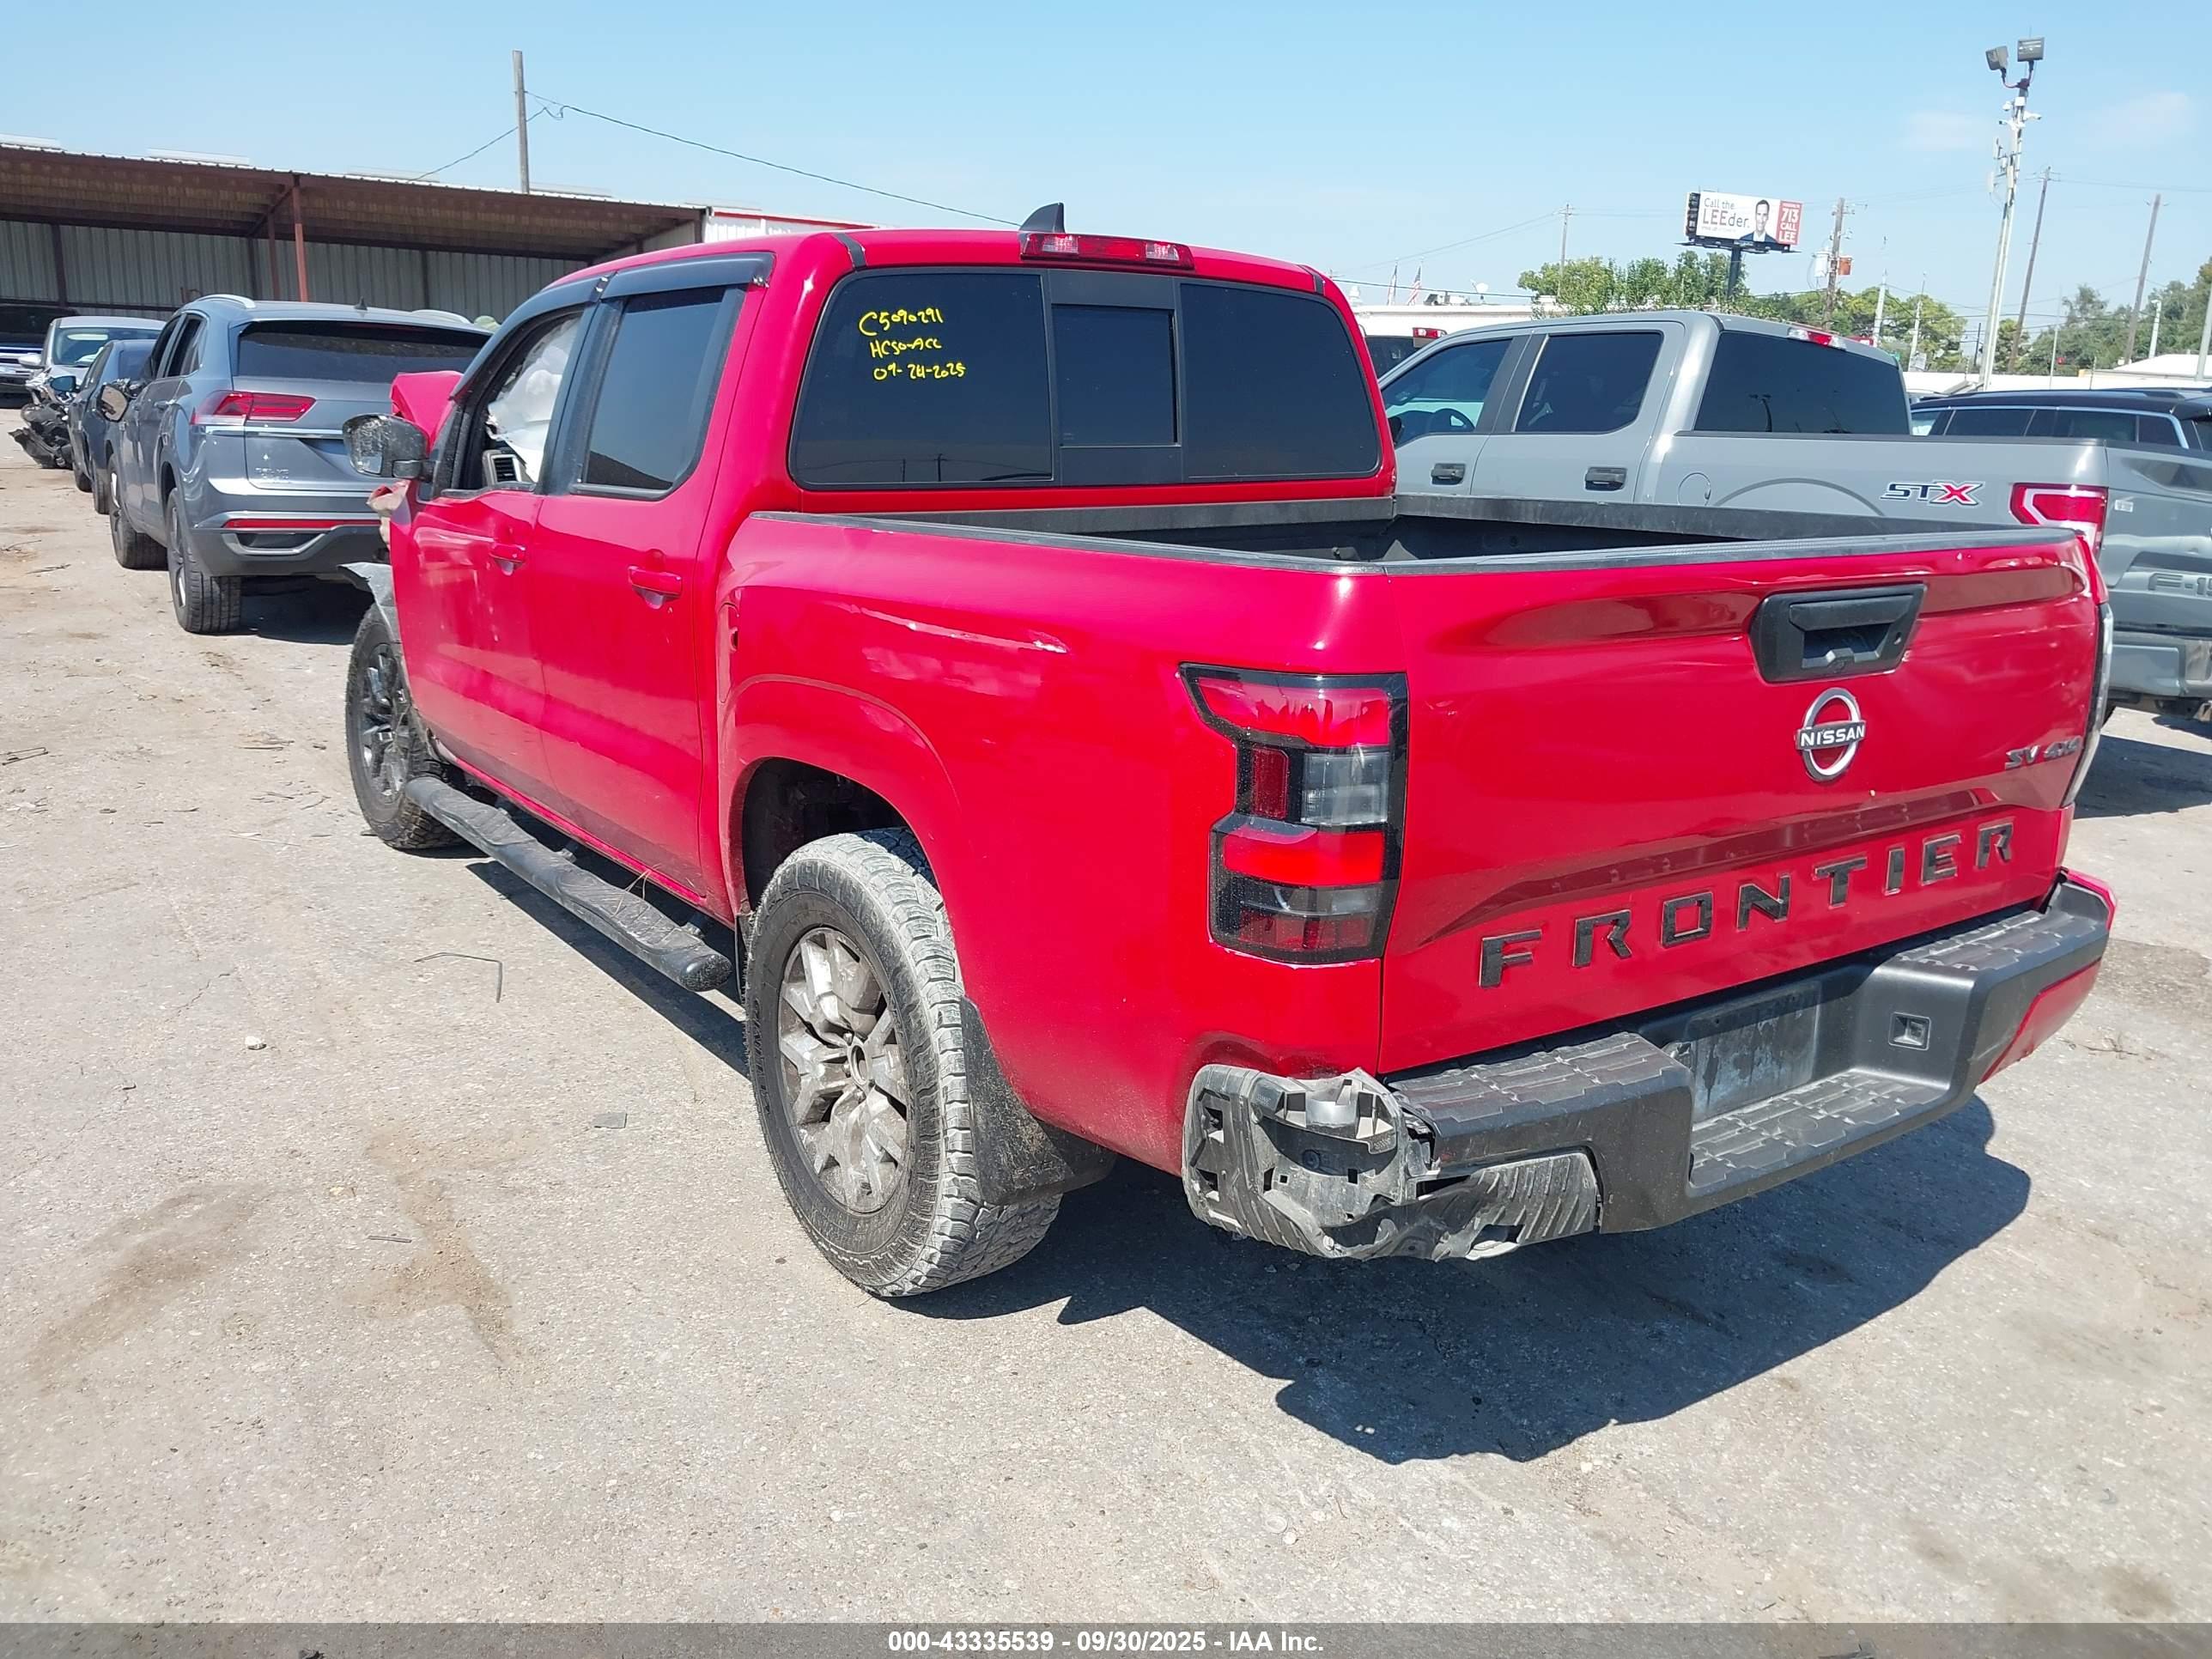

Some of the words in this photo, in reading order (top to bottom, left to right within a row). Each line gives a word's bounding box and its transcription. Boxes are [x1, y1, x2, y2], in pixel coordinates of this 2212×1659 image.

[1704, 198, 1720, 208] Call
[1722, 201, 1735, 210] the
[1781, 208, 1799, 223] 713
[1779, 222, 1797, 232] CALL
[1778, 230, 1796, 244] LEE
[1881, 479, 1984, 507] STX
[1800, 725, 1865, 747] NISSAN
[2004, 744, 2040, 769] SV
[1478, 820, 2015, 989] FRONTIER
